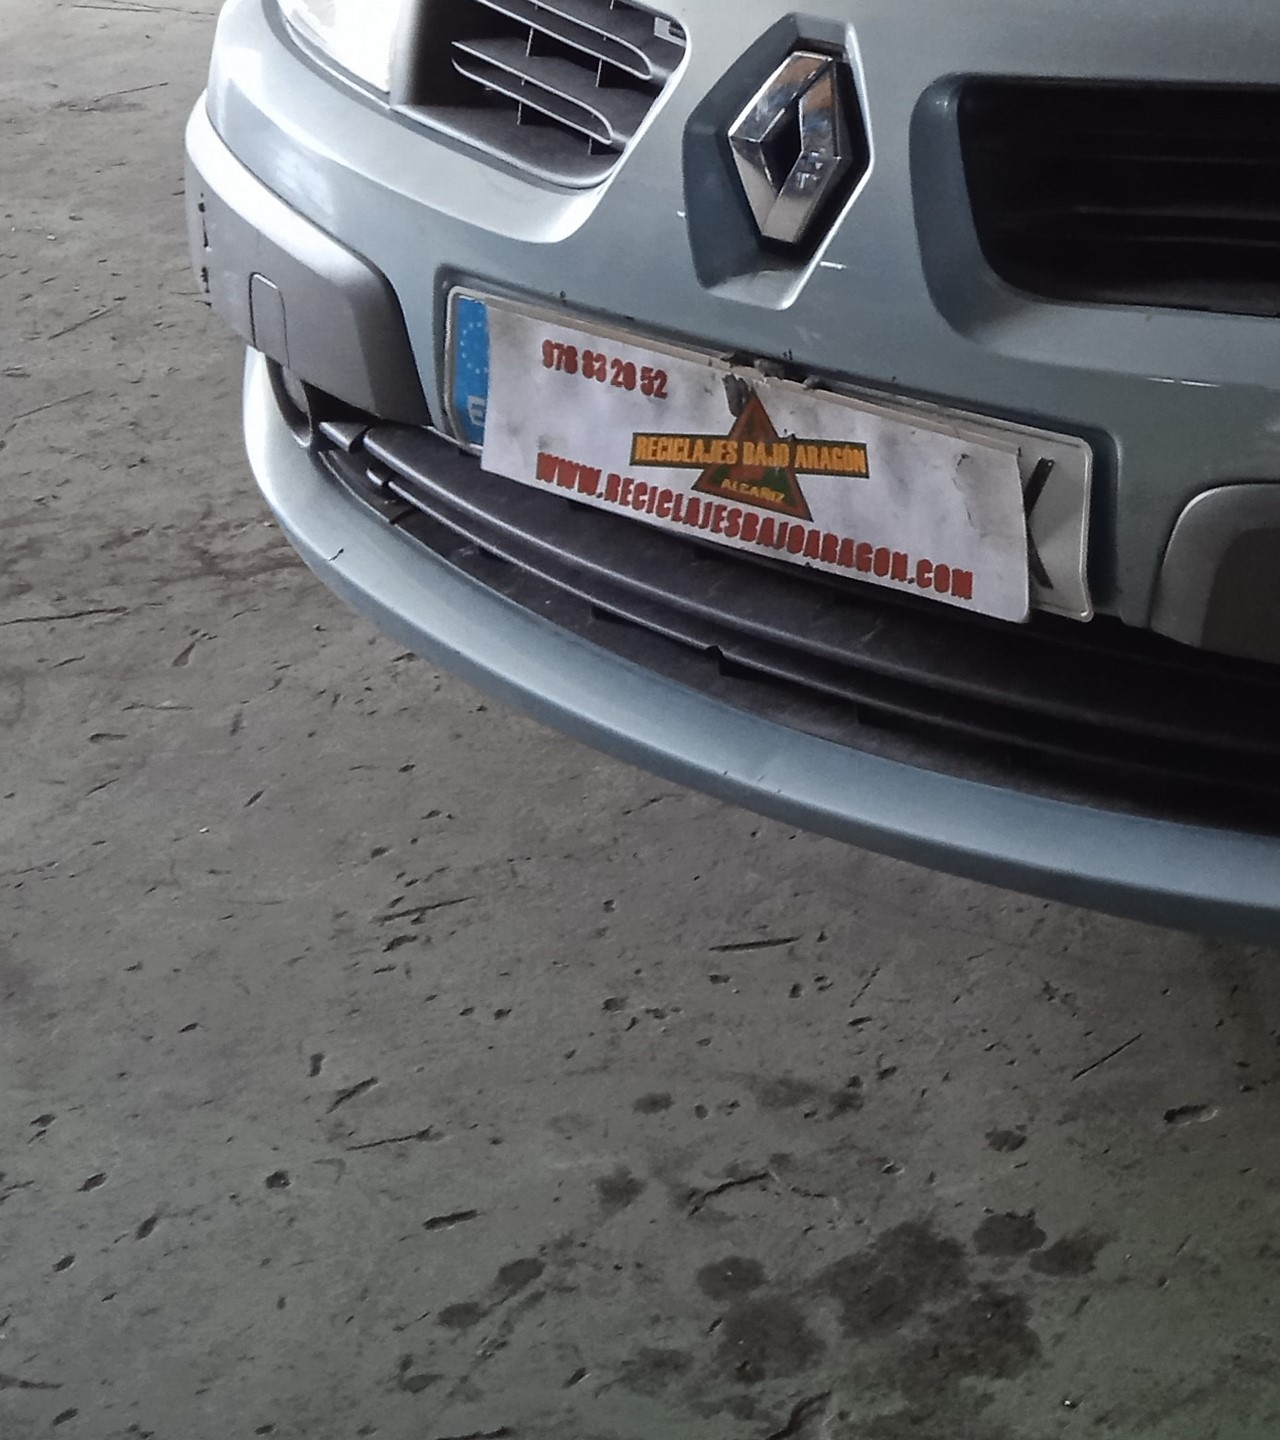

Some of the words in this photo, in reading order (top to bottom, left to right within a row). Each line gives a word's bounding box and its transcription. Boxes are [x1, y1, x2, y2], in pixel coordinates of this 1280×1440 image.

[640, 365, 669, 399] 52
[635, 435, 738, 465] RECICLAJES
[743, 441, 790, 468] BAJO
[535, 451, 974, 601] WWW.RECICLAJESBAJOARAGON.COM
